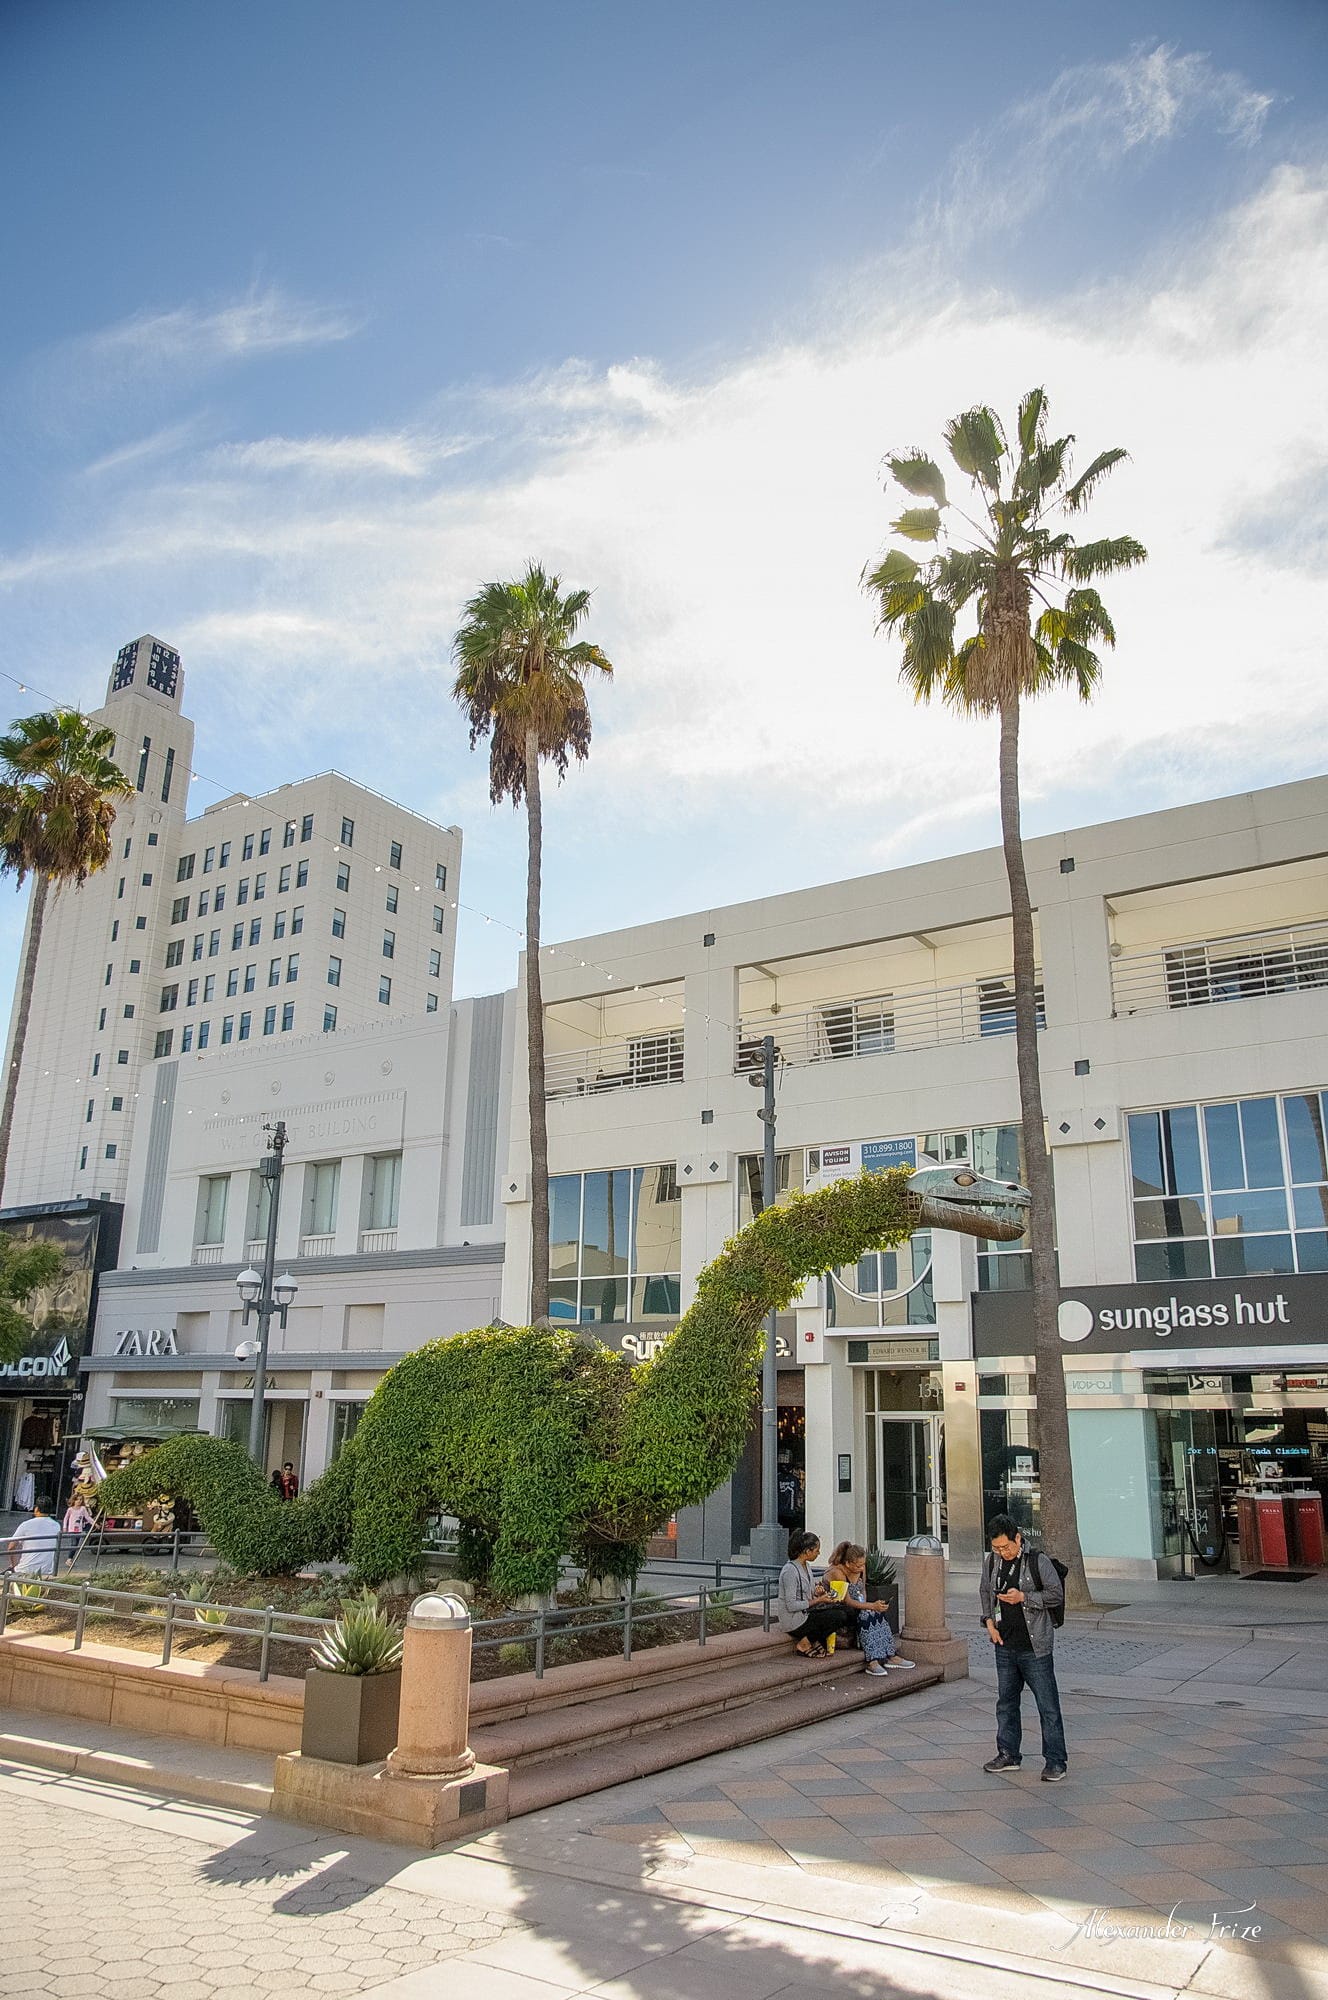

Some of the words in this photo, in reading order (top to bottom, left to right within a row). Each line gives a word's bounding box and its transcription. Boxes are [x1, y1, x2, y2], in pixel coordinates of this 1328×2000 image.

[863, 1141, 913, 1154] 310.899.1800
[1099, 1296, 1229, 1337] sunglass
[1234, 1293, 1290, 1325] hut
[113, 1328, 180, 1356] ZARA
[0, 1357, 68, 1376] LCOM
[243, 1376, 279, 1389] ZA
[1187, 1447, 1202, 1455] for
[1031, 1525, 1042, 1537] hu
